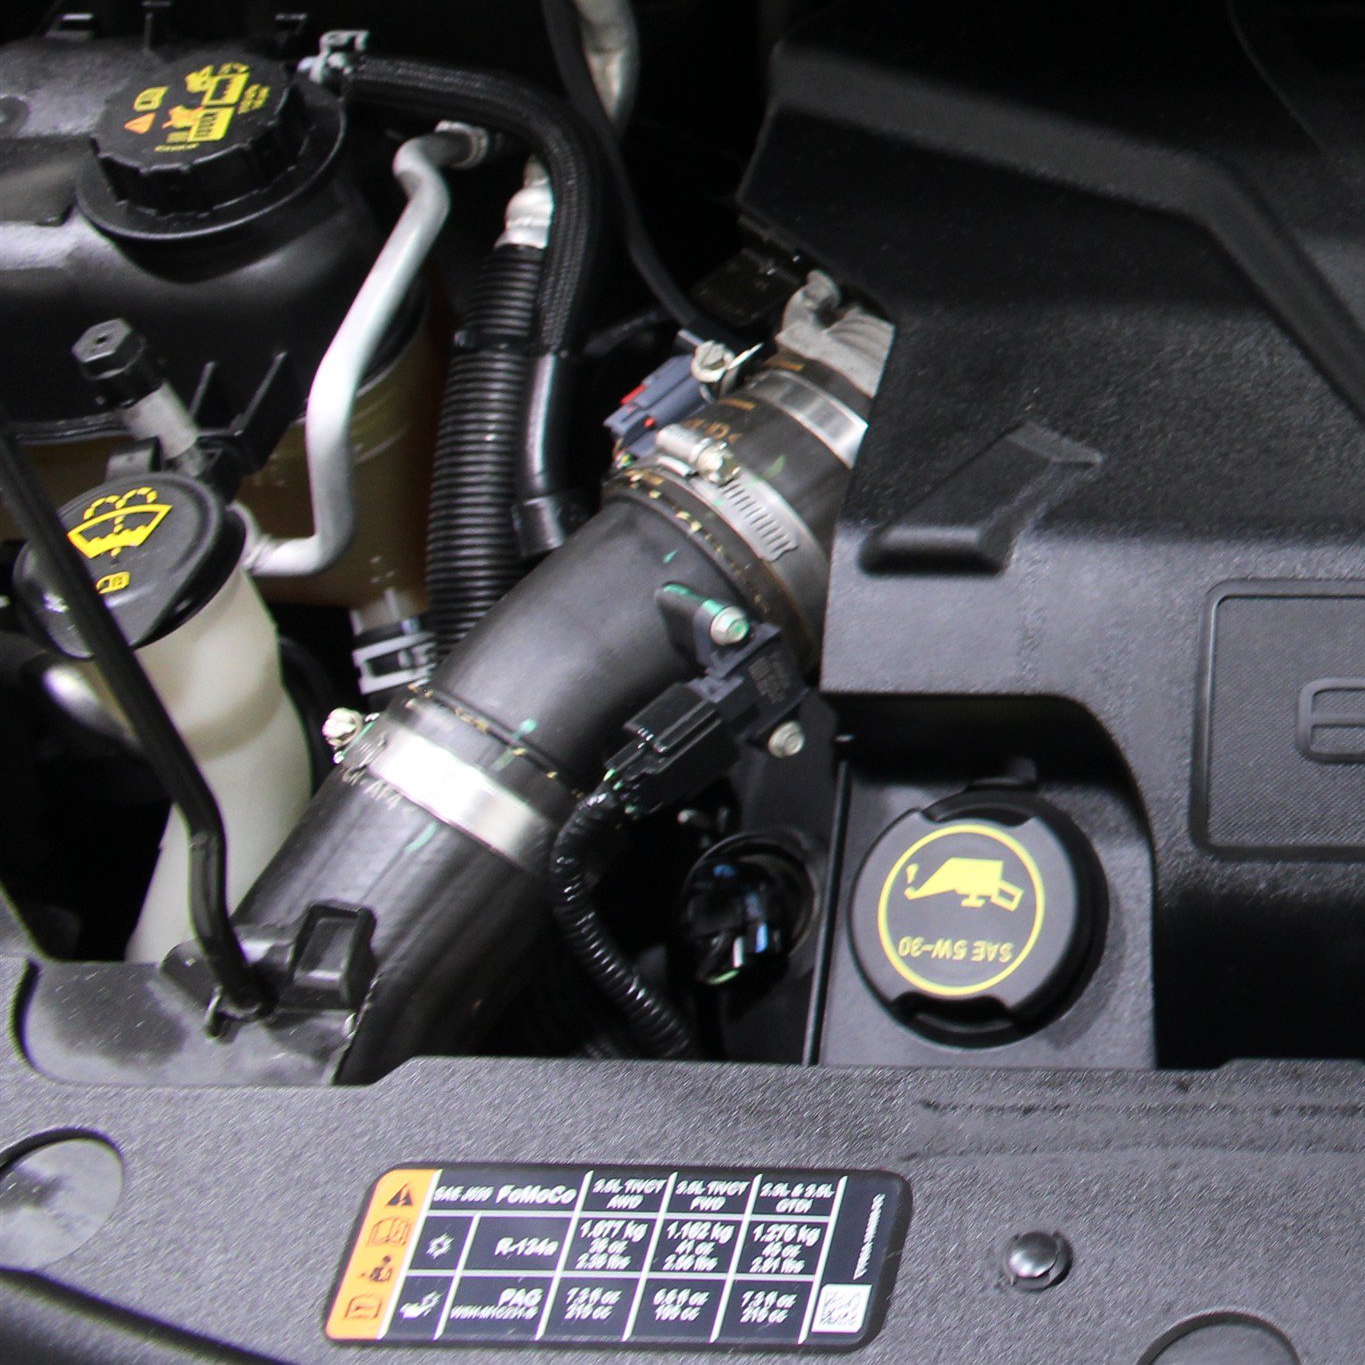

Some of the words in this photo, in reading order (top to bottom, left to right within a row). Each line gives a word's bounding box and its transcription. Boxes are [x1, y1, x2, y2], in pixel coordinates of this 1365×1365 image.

[897, 935, 968, 960] 5W-30
[971, 939, 1015, 964] SAE
[495, 1184, 578, 1205] FoMoCo
[606, 1194, 644, 1210] AWD
[689, 1196, 727, 1211] FWD
[621, 1220, 649, 1243] kg
[709, 1221, 736, 1244] kg
[796, 1224, 822, 1247] kg
[494, 1237, 560, 1256] R-134a
[497, 1287, 544, 1307] PAG
